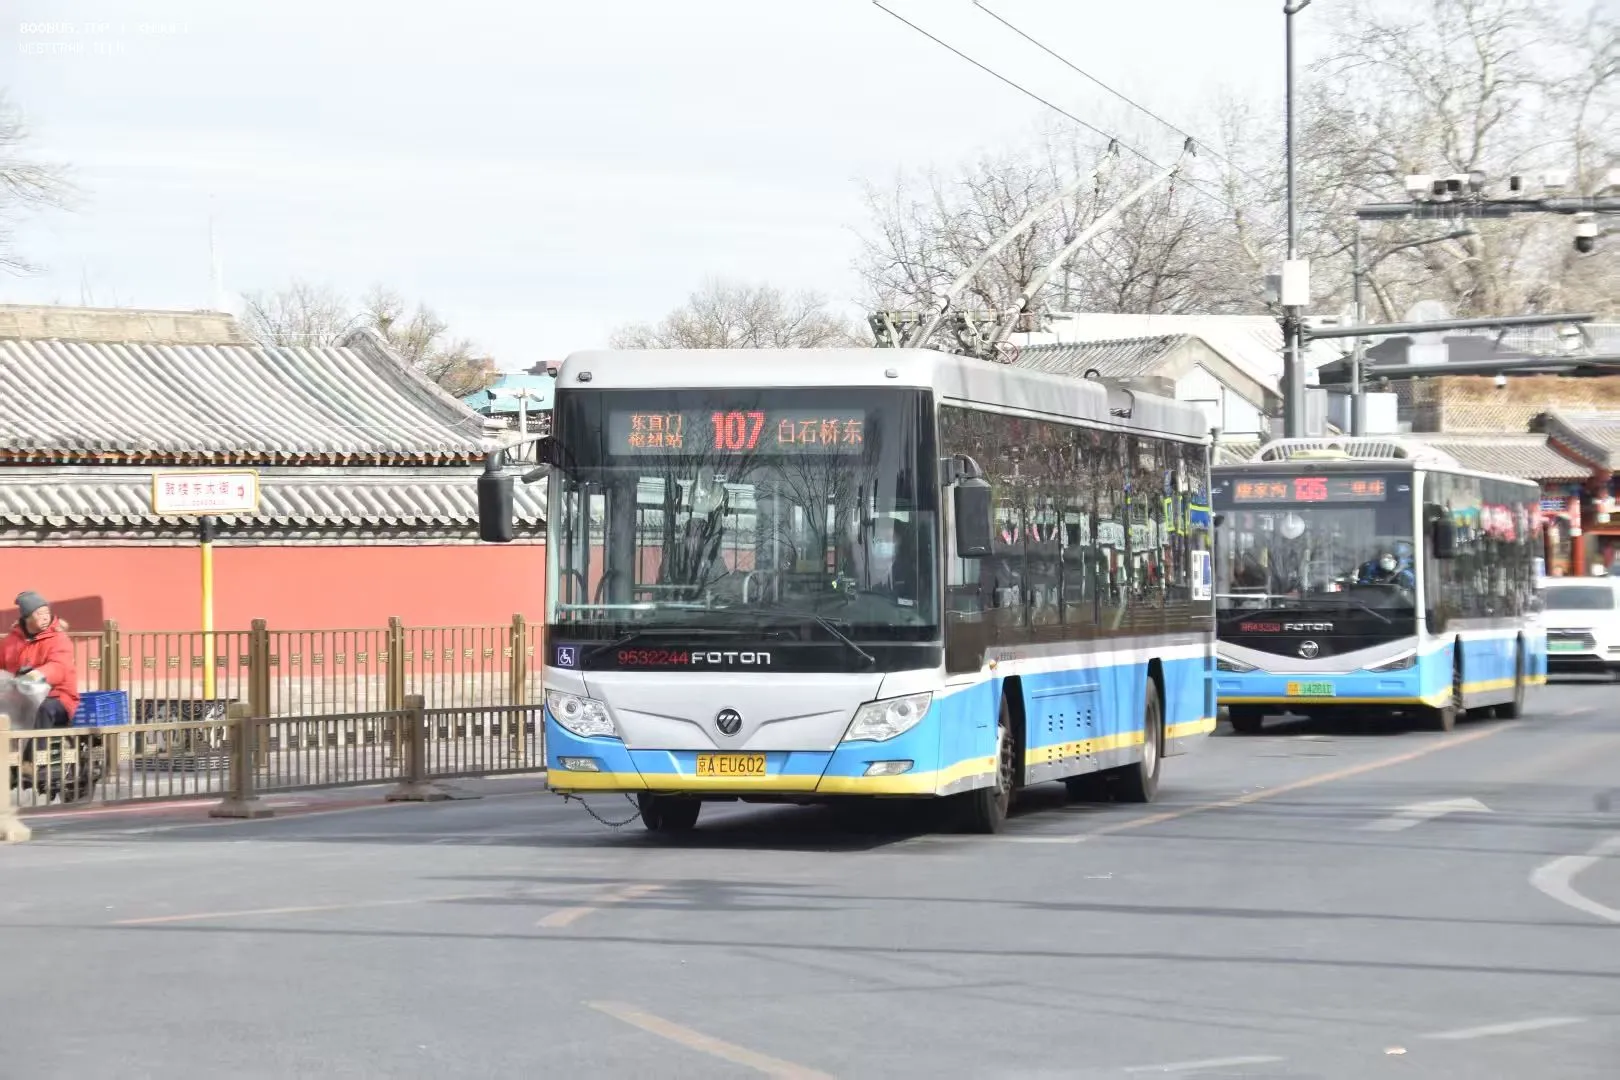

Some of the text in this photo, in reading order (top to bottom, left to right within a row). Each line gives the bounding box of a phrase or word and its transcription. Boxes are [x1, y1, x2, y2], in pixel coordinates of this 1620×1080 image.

[631, 413, 683, 431] 东直门
[711, 411, 765, 450] 107
[628, 432, 683, 449] 枢纽站
[778, 419, 863, 446] 白石桥东
[1284, 622, 1334, 632] FOTON
[617, 651, 771, 665] 9532244 FOTON
